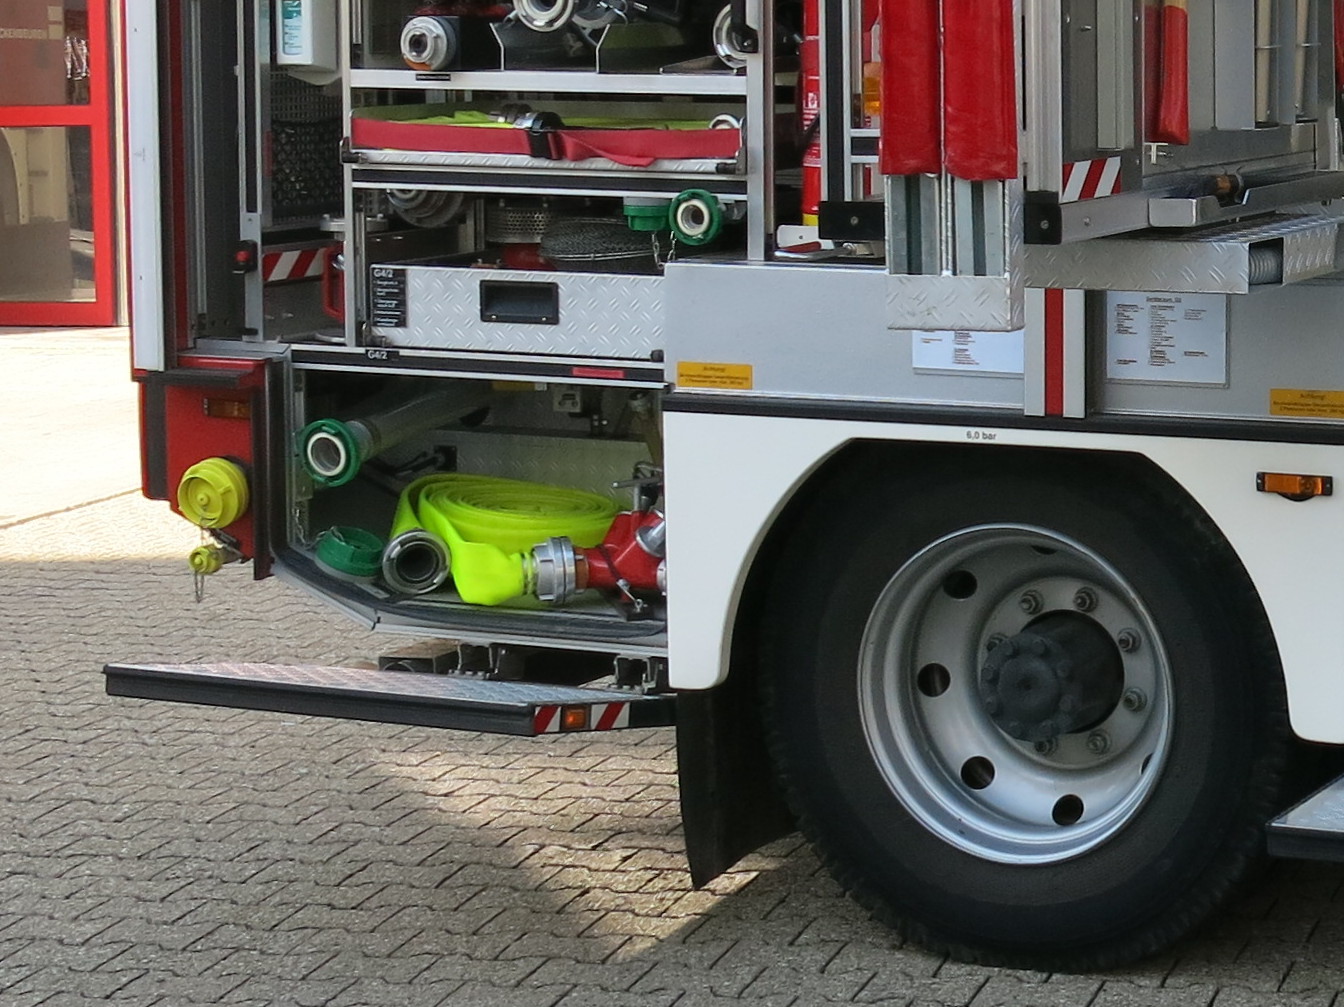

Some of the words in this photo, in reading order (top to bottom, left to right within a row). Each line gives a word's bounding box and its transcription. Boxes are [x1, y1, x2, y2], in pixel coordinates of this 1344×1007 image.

[373, 269, 394, 278] G4/2
[367, 350, 388, 359] G4/2
[982, 431, 996, 440] bar
